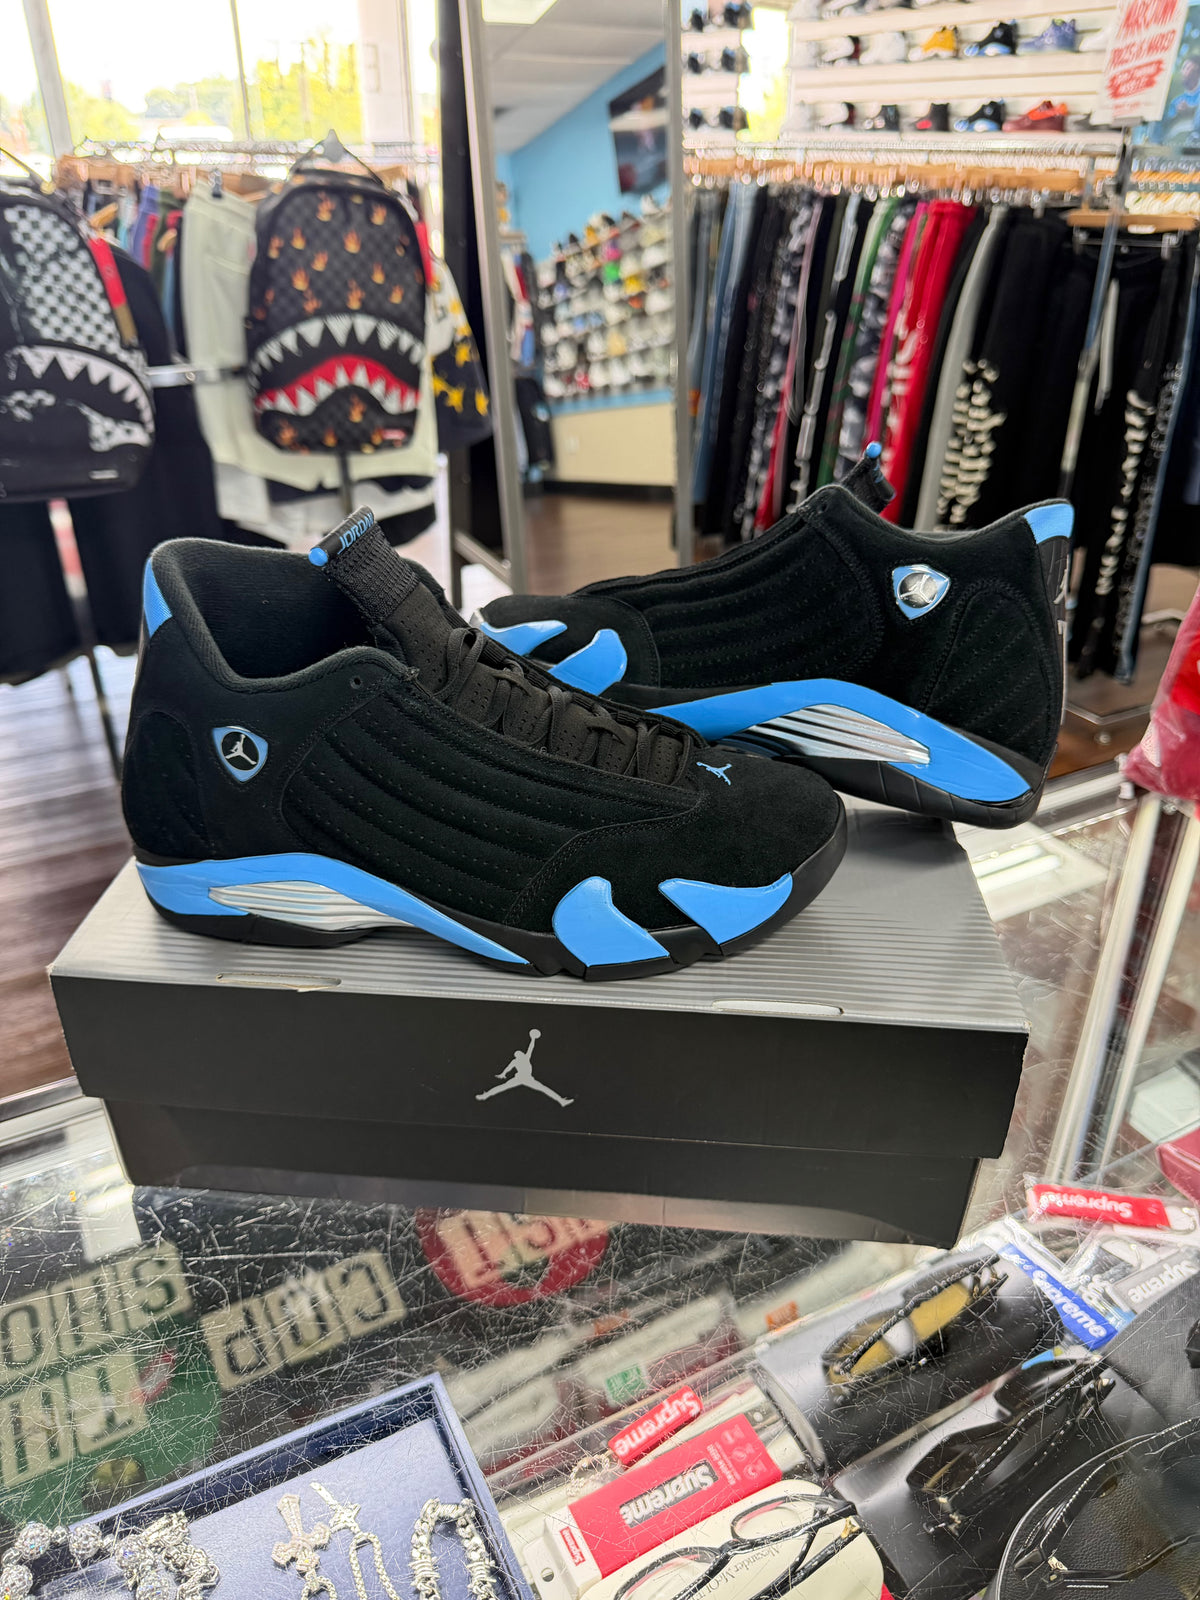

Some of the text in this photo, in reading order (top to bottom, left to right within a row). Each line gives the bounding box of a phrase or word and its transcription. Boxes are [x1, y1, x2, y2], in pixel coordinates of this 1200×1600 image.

[338, 512, 374, 555] JORDAN
[1043, 1190, 1134, 1219] Suprem
[1127, 1259, 1199, 1304] Supreme
[613, 1390, 701, 1456] Supreme
[619, 1462, 715, 1525] Supreme
